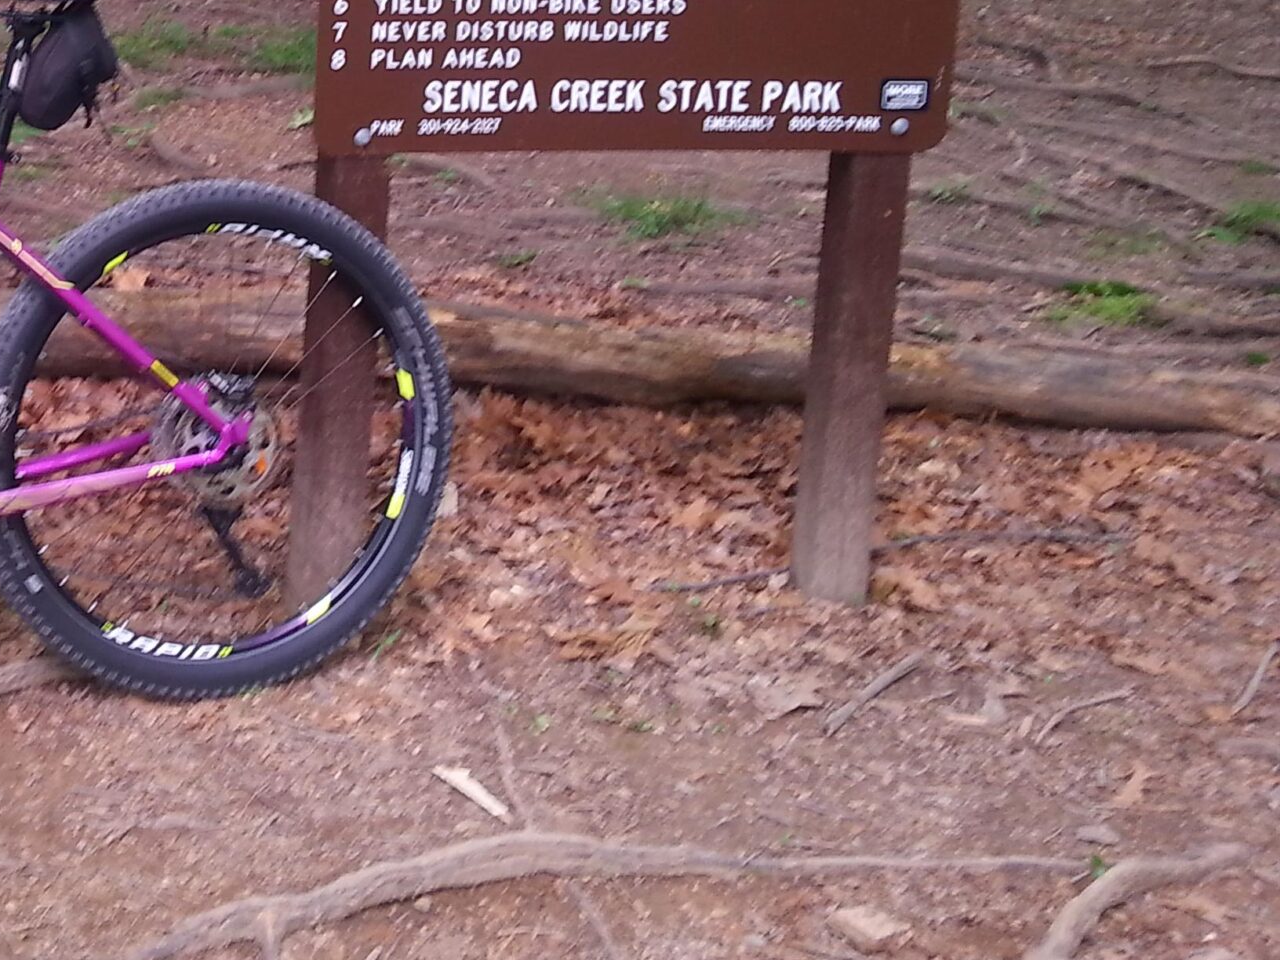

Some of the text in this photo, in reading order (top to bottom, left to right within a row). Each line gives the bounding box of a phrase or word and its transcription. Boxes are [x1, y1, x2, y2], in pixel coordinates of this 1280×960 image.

[332, 20, 669, 43] 7 NEVER DISTURB WILDLIFE
[330, 47, 521, 71] 8 PLAN AHEAD
[423, 79, 842, 114] SENECA CREEK STATE PARK
[369, 119, 405, 137] PARK
[102, 626, 221, 661] RAPID
